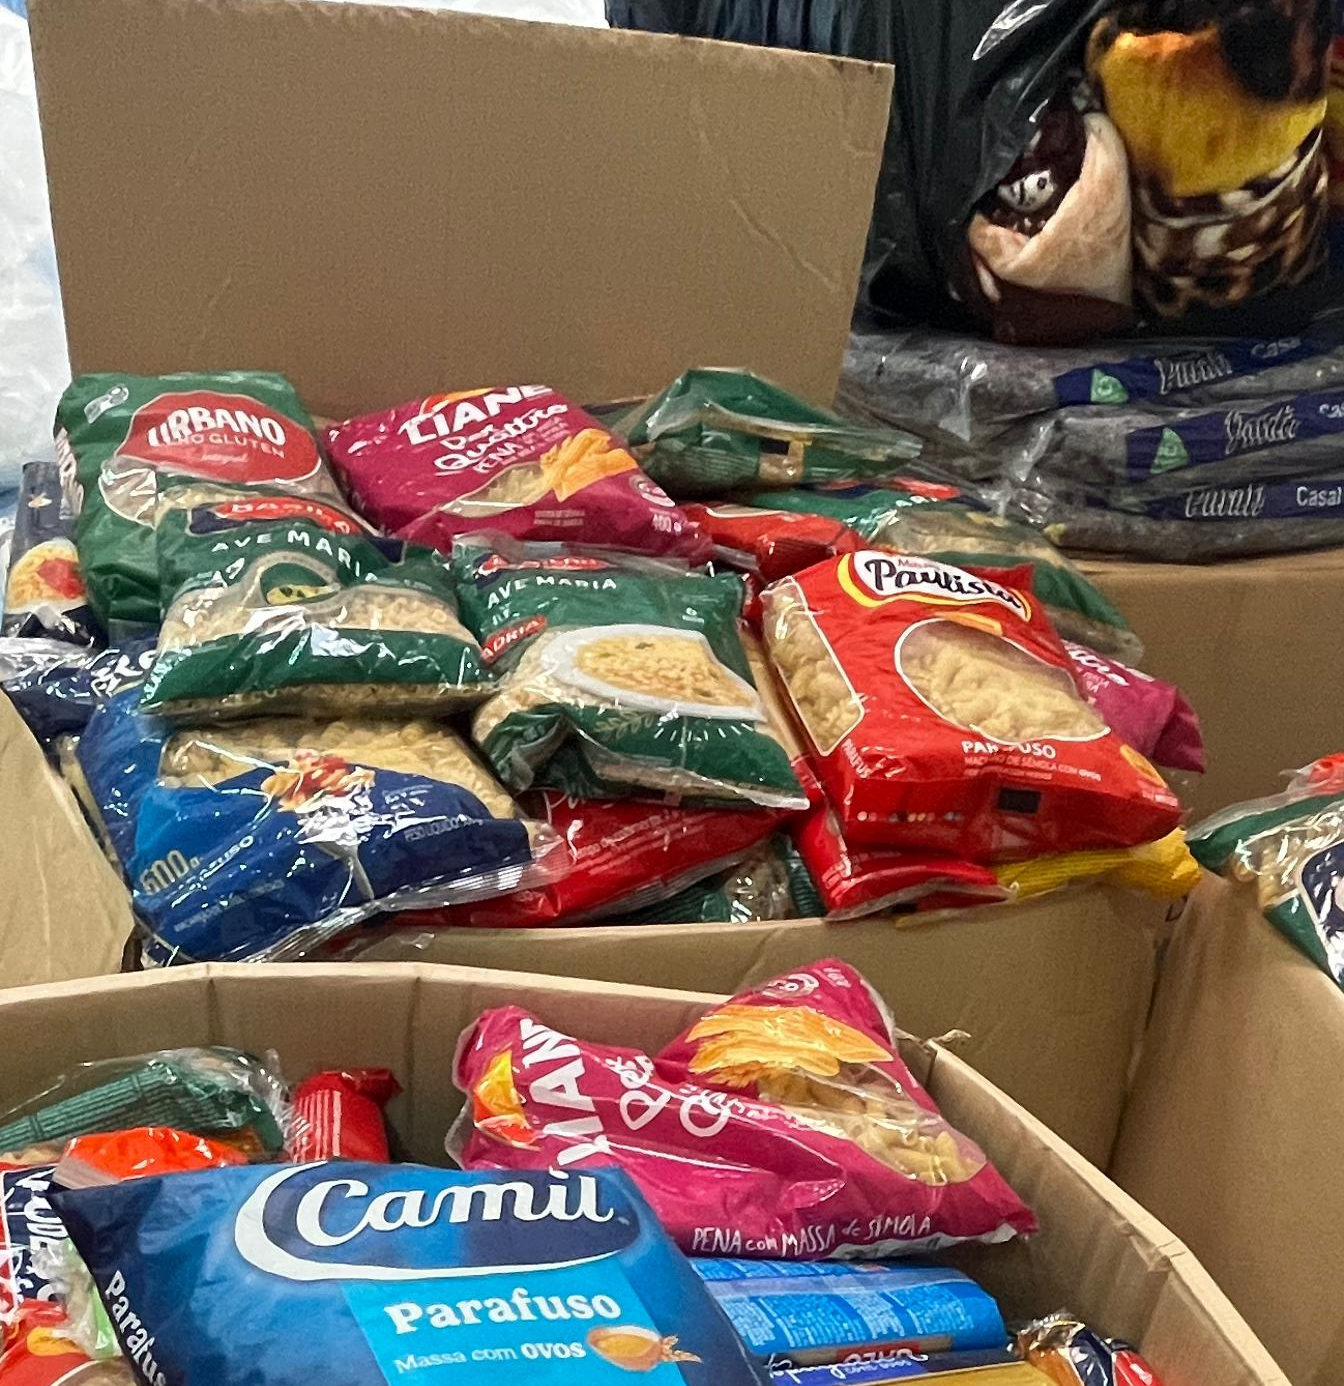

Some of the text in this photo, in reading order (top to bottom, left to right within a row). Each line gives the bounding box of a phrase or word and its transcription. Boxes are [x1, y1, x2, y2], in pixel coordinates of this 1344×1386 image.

[146, 405, 287, 448] URBANO
[1296, 485, 1344, 508] Casal
[211, 532, 273, 553] AVE
[487, 577, 528, 609] AVE
[295, 1169, 617, 1248] Camil
[691, 1226, 743, 1255] PENA
[780, 1223, 838, 1258] MASSA
[383, 1286, 623, 1336] Parafuso
[393, 1348, 468, 1376] Massa
[471, 1345, 518, 1362] com
